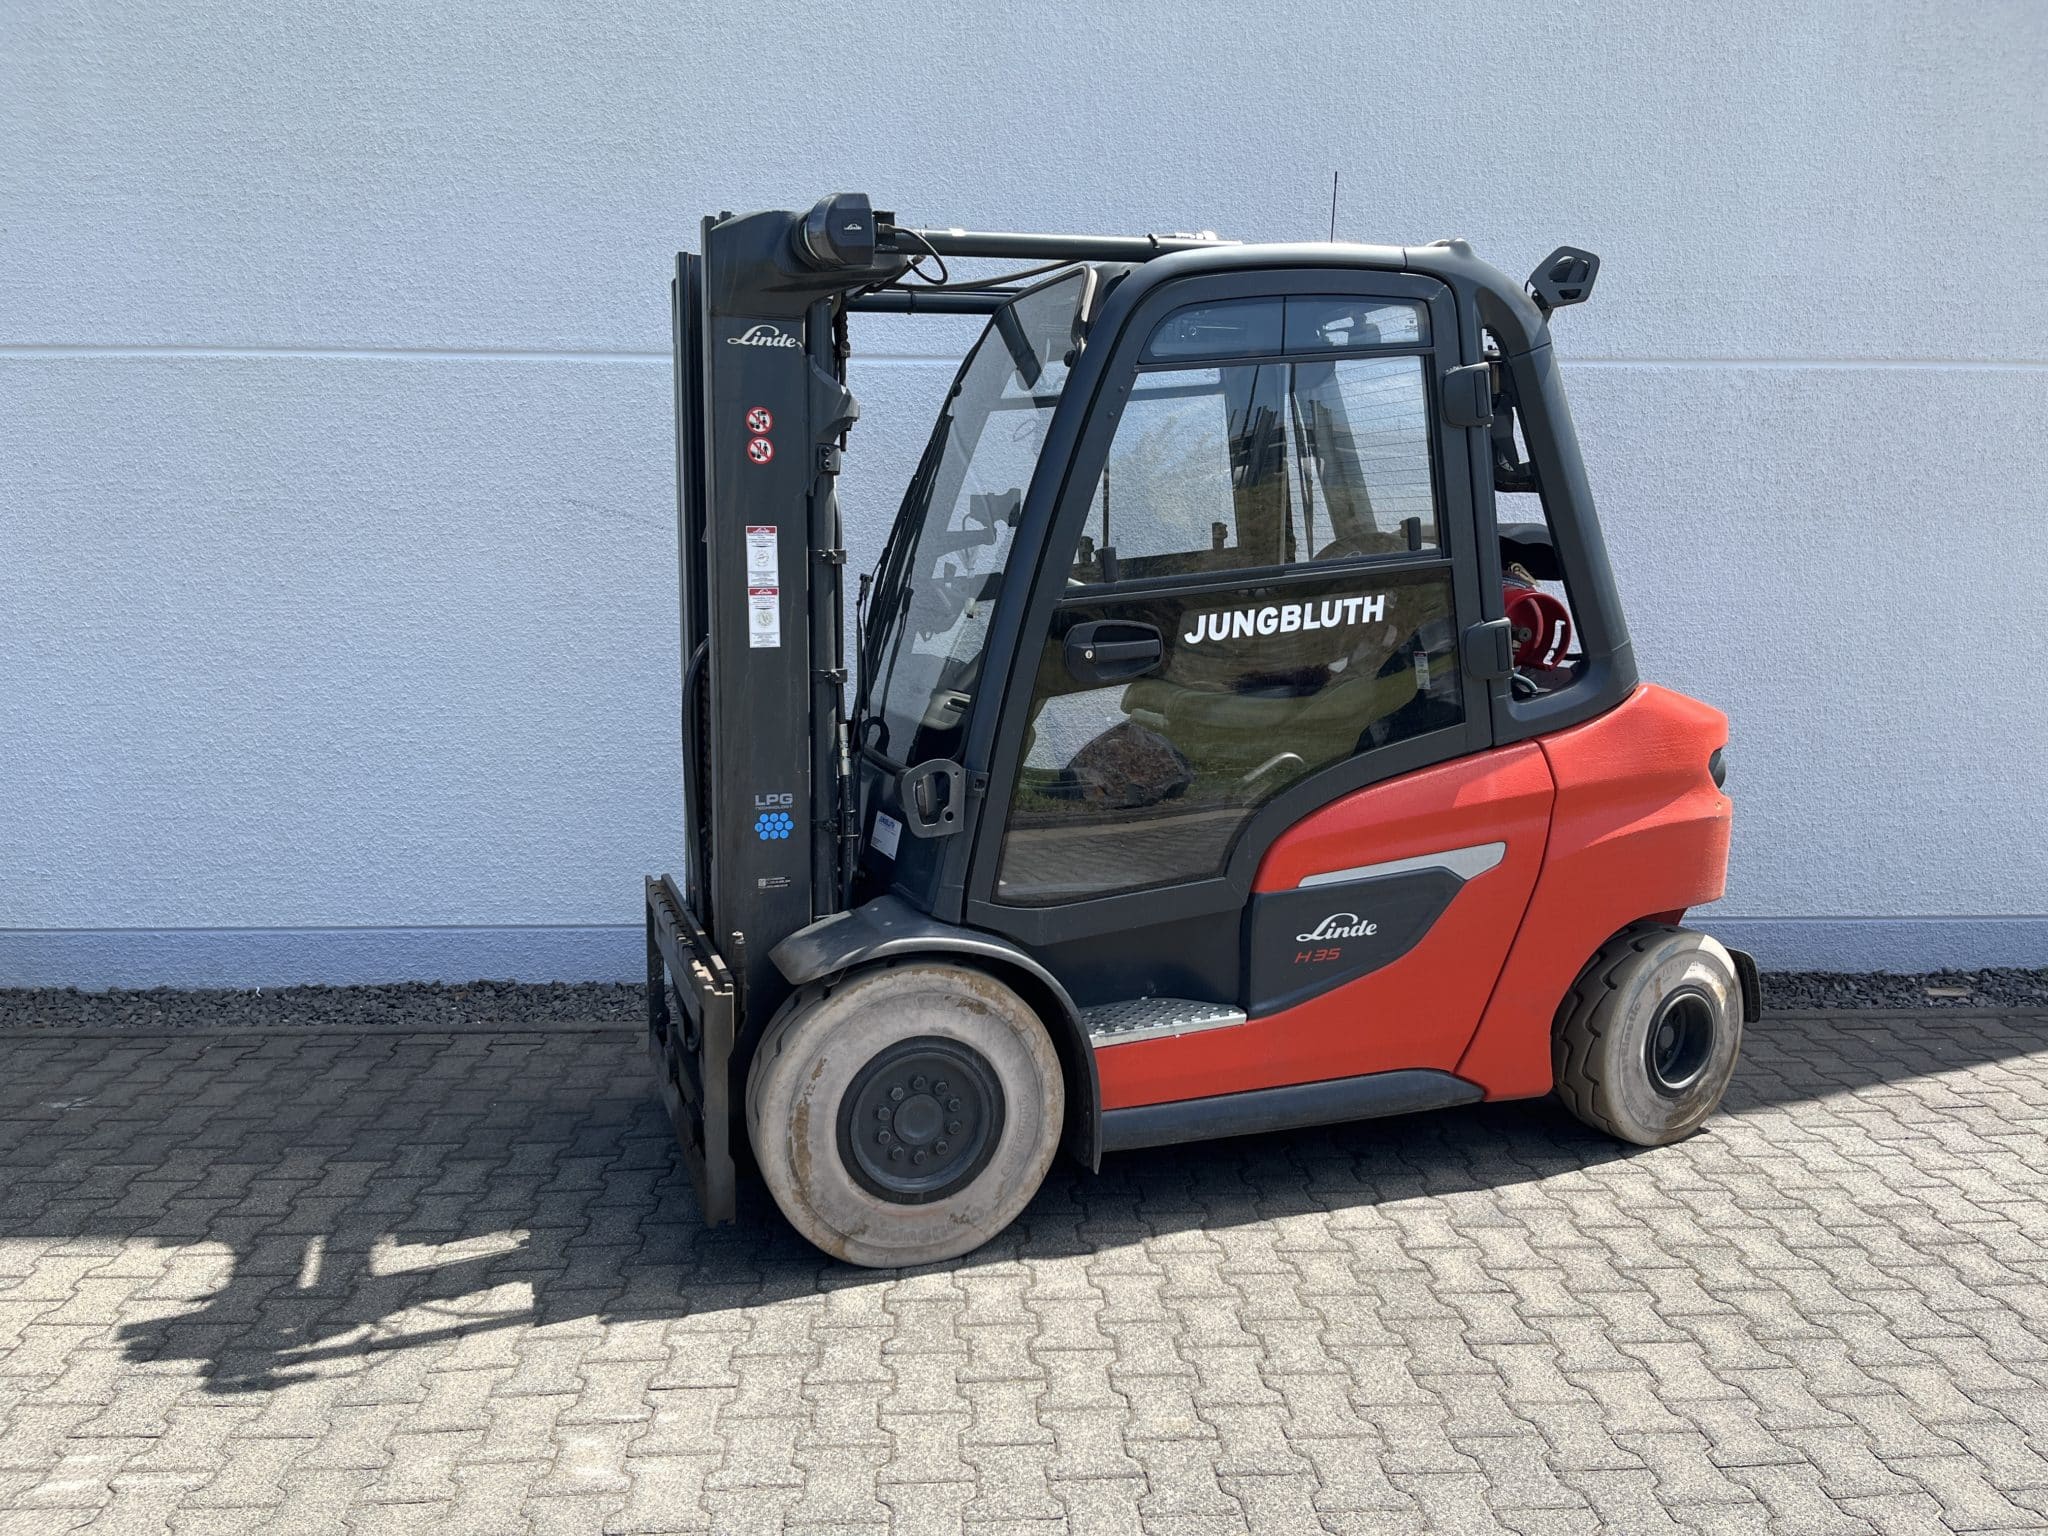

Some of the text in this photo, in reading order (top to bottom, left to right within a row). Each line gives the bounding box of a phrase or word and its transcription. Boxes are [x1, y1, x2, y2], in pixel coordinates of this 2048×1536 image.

[727, 324, 797, 348] Linde
[1184, 595, 1385, 645] JUNGBLUTH
[754, 793, 793, 806] LPG
[1296, 912, 1378, 942] Linde
